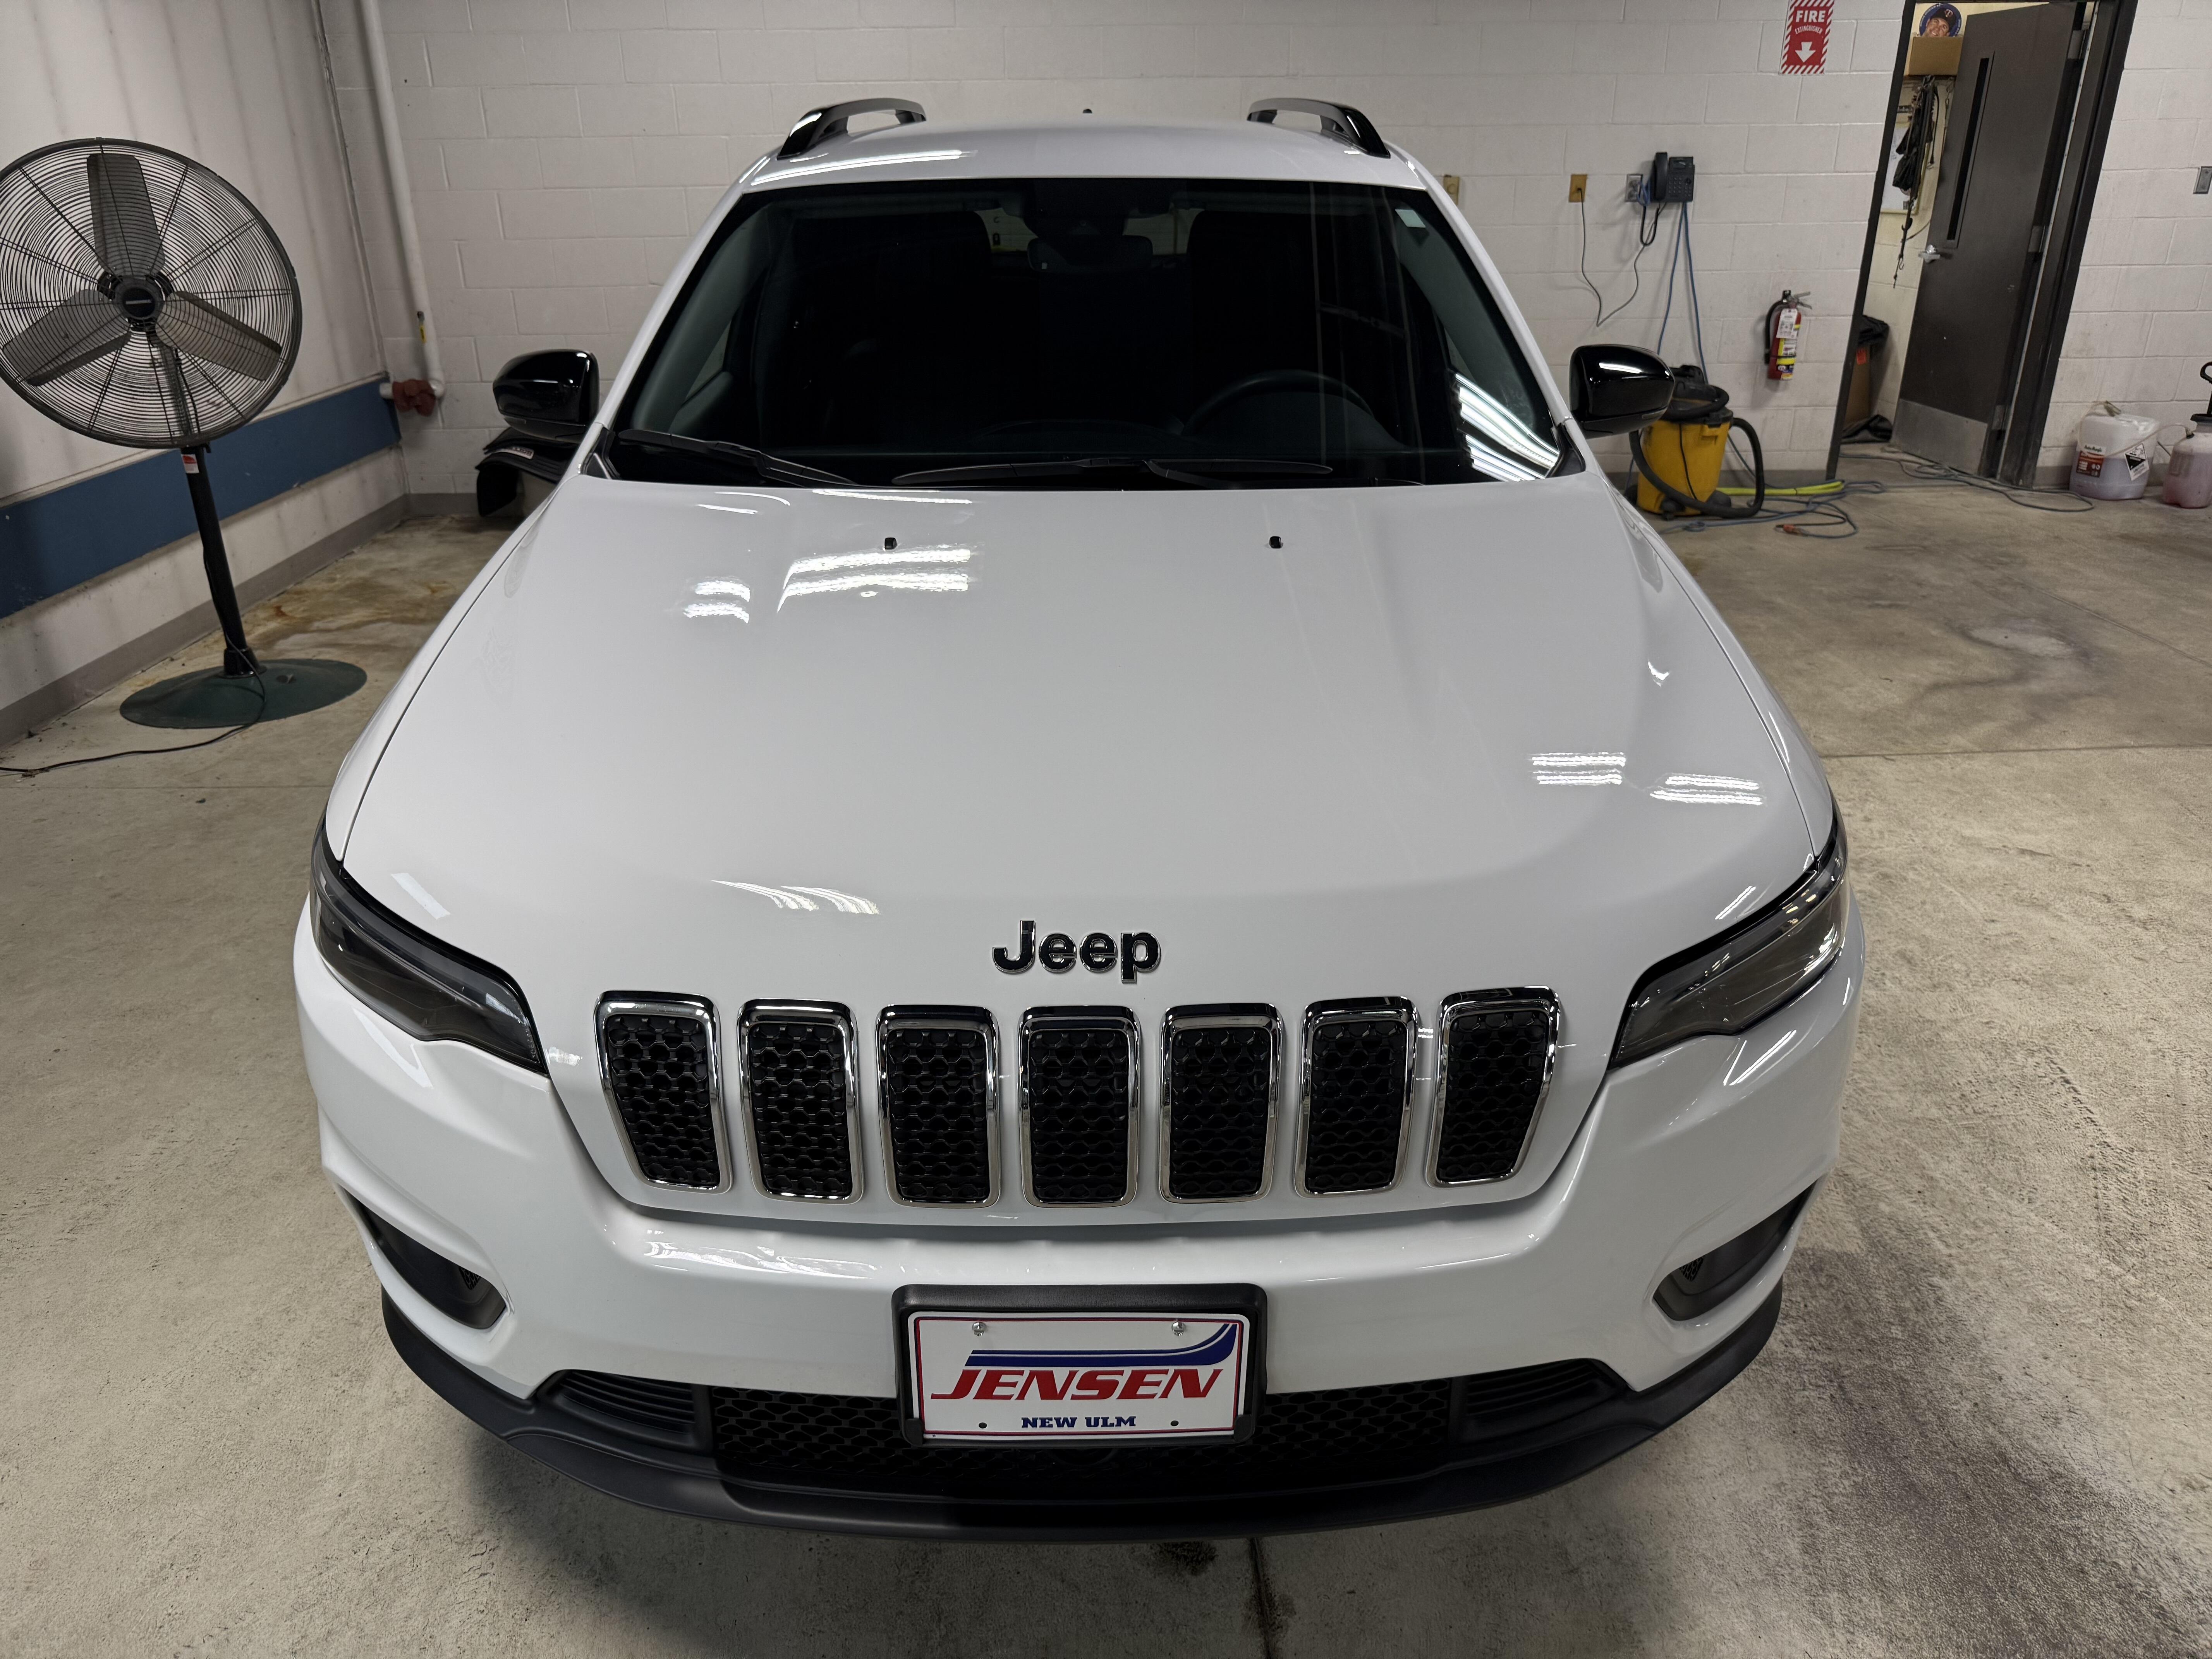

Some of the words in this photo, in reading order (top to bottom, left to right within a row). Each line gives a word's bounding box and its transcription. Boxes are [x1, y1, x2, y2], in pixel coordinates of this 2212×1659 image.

[1796, 10, 1826, 22] FIRE
[992, 920, 1162, 984] Jeep
[931, 1369, 1224, 1400] JENSEN
[1021, 1417, 1078, 1428] NEW
[1085, 1416, 1136, 1427] ULM
